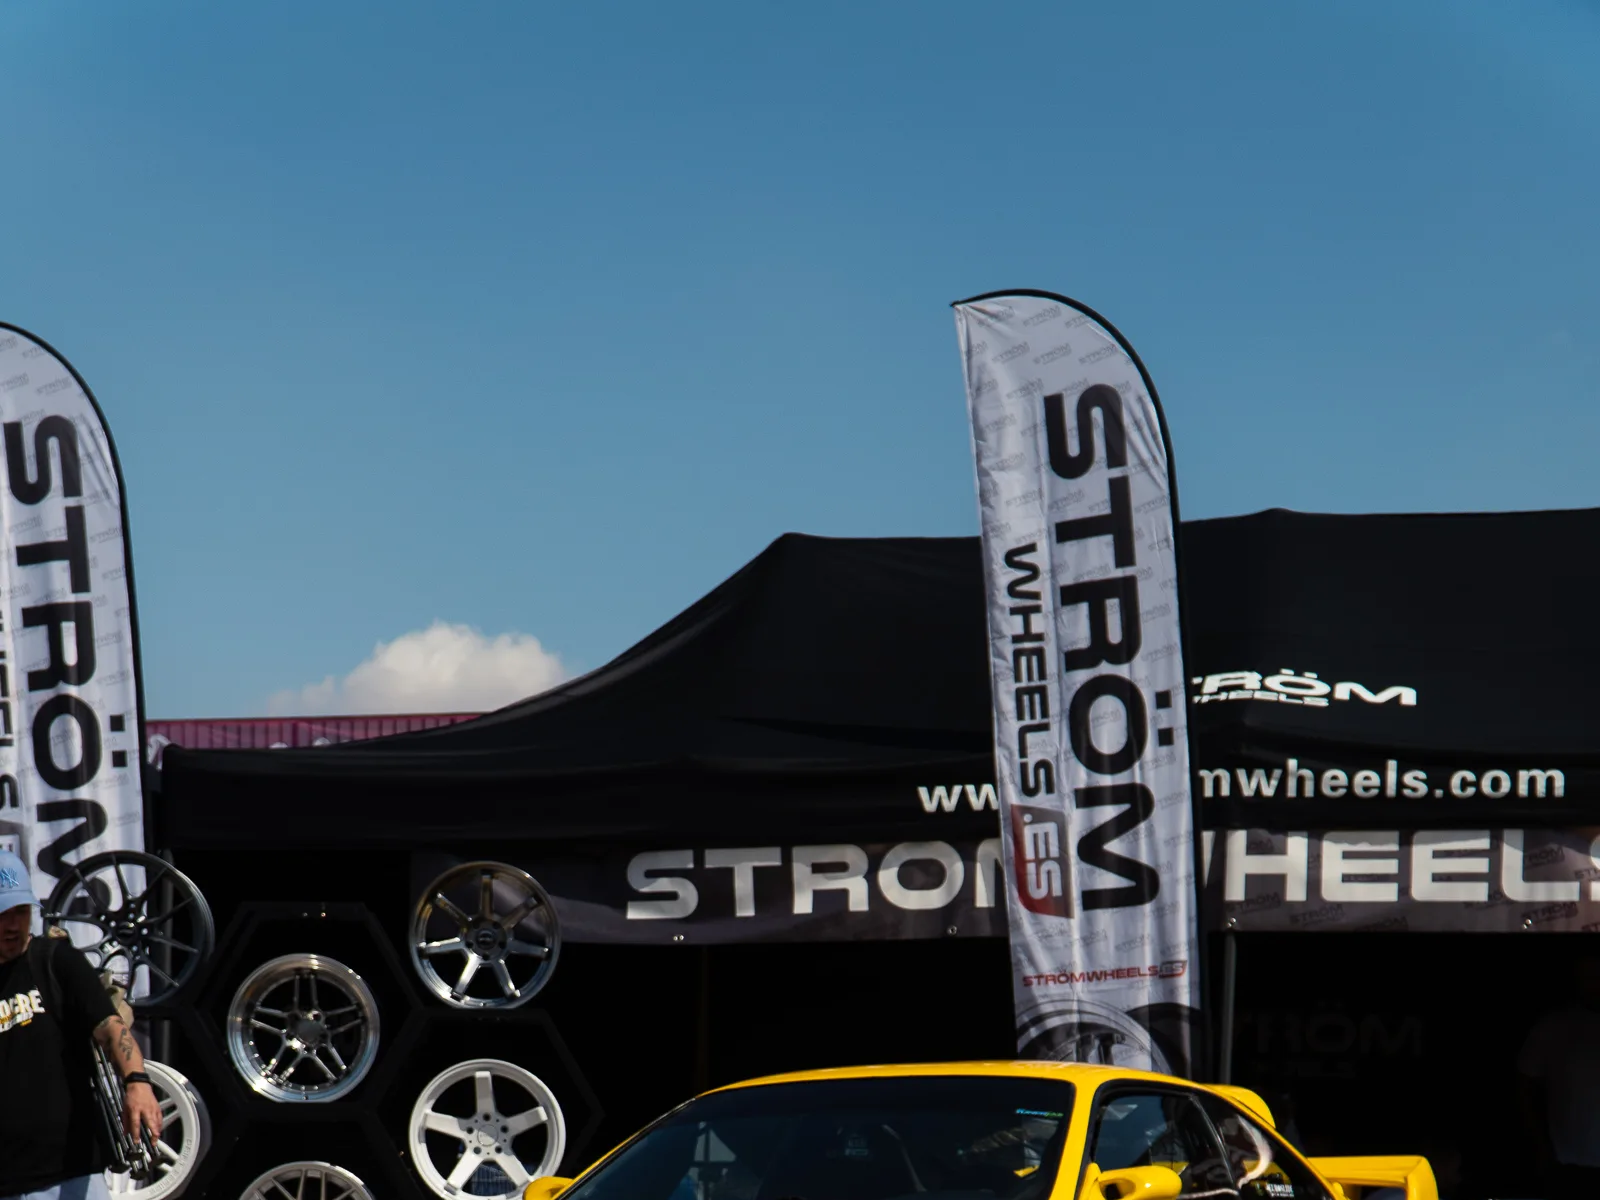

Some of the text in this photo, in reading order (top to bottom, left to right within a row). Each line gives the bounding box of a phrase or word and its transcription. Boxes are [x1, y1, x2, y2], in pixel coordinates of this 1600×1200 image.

[1004, 543, 1056, 798] WHEELS
[1043, 383, 1175, 911] STRÖM
[1192, 668, 1417, 706] RÖM
[1201, 829, 1600, 902] HEEL
